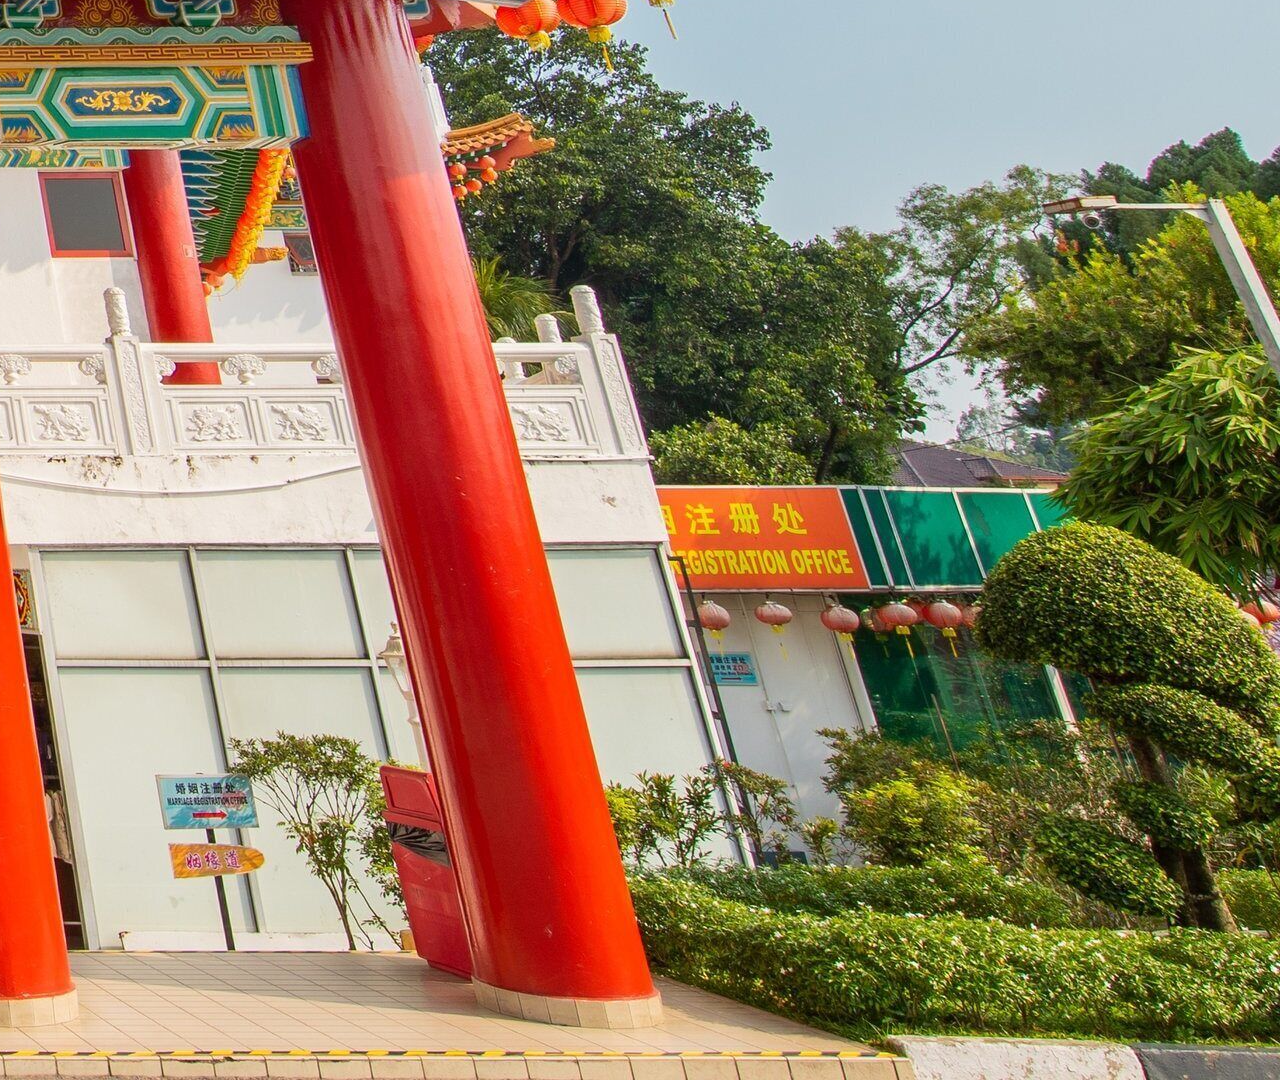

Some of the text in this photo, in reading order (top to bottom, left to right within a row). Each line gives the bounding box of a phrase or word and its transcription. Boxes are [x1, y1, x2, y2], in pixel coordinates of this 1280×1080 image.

[791, 549, 854, 575] OFFICE
[167, 797, 193, 806] MARRIAGE
[193, 797, 230, 806] REGISTRATION
